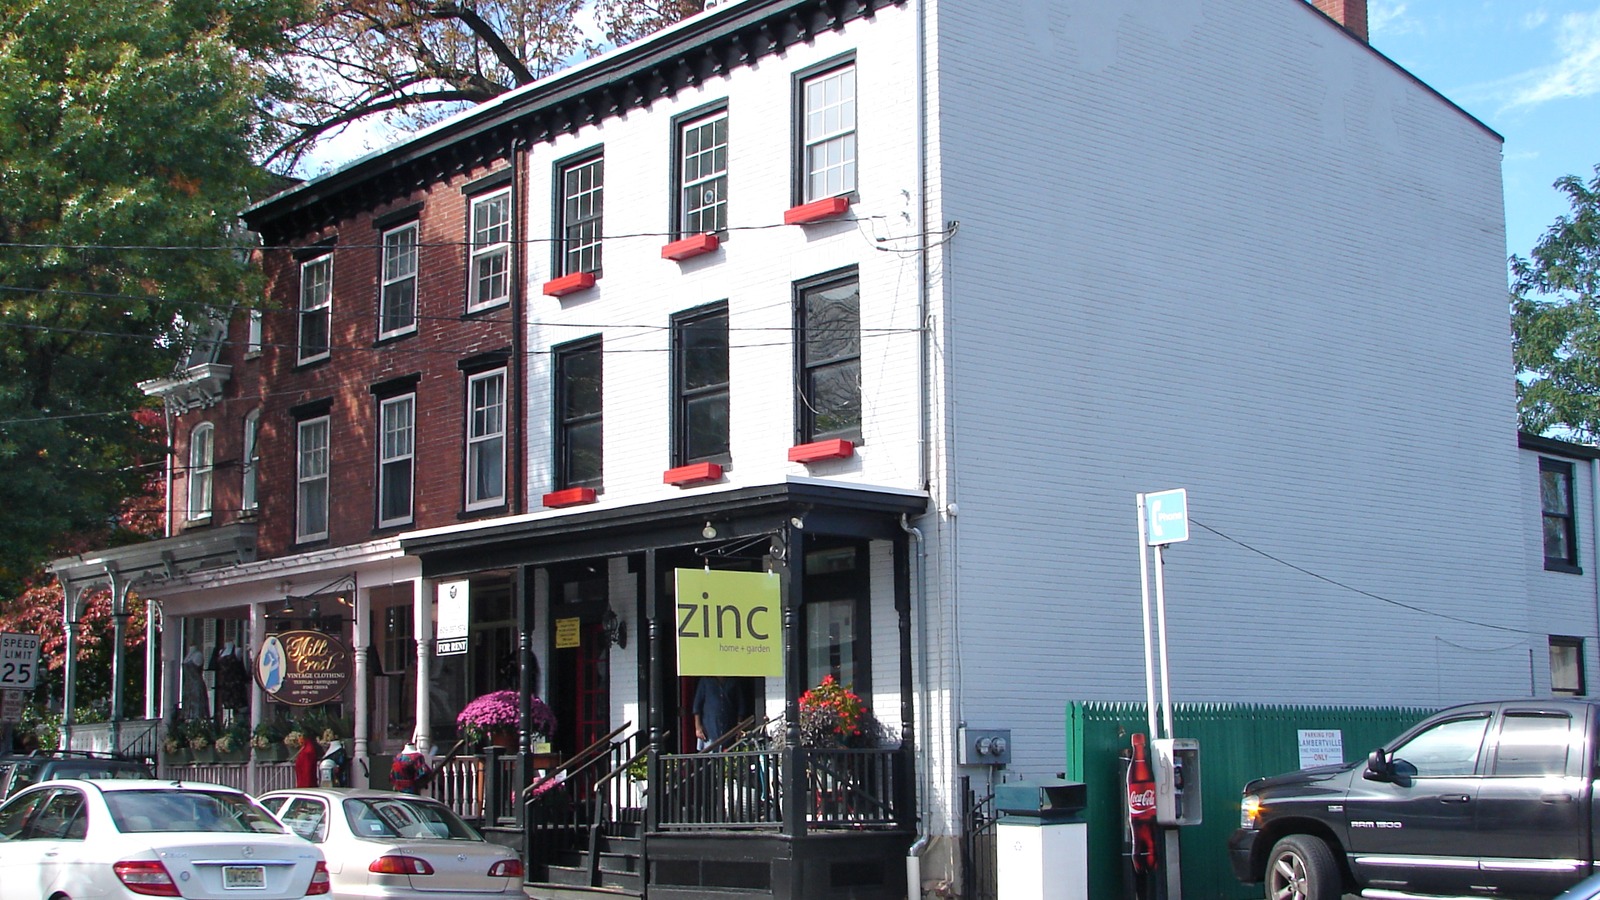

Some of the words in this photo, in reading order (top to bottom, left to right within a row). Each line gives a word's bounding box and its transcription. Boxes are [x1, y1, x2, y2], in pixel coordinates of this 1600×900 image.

[1158, 511, 1183, 521] Phone
[678, 592, 769, 640] zinc
[3, 638, 37, 649] SPEED
[286, 636, 329, 661] Mill
[438, 643, 450, 653] FOR
[451, 641, 466, 651] RENT
[719, 643, 739, 652] home
[746, 644, 771, 654] garden
[5, 650, 33, 659] LIMIT
[296, 652, 345, 673] Crest
[2, 662, 31, 683] 25
[1299, 739, 1342, 747] LAMBERTVILLE
[1313, 753, 1328, 761] ONLY
